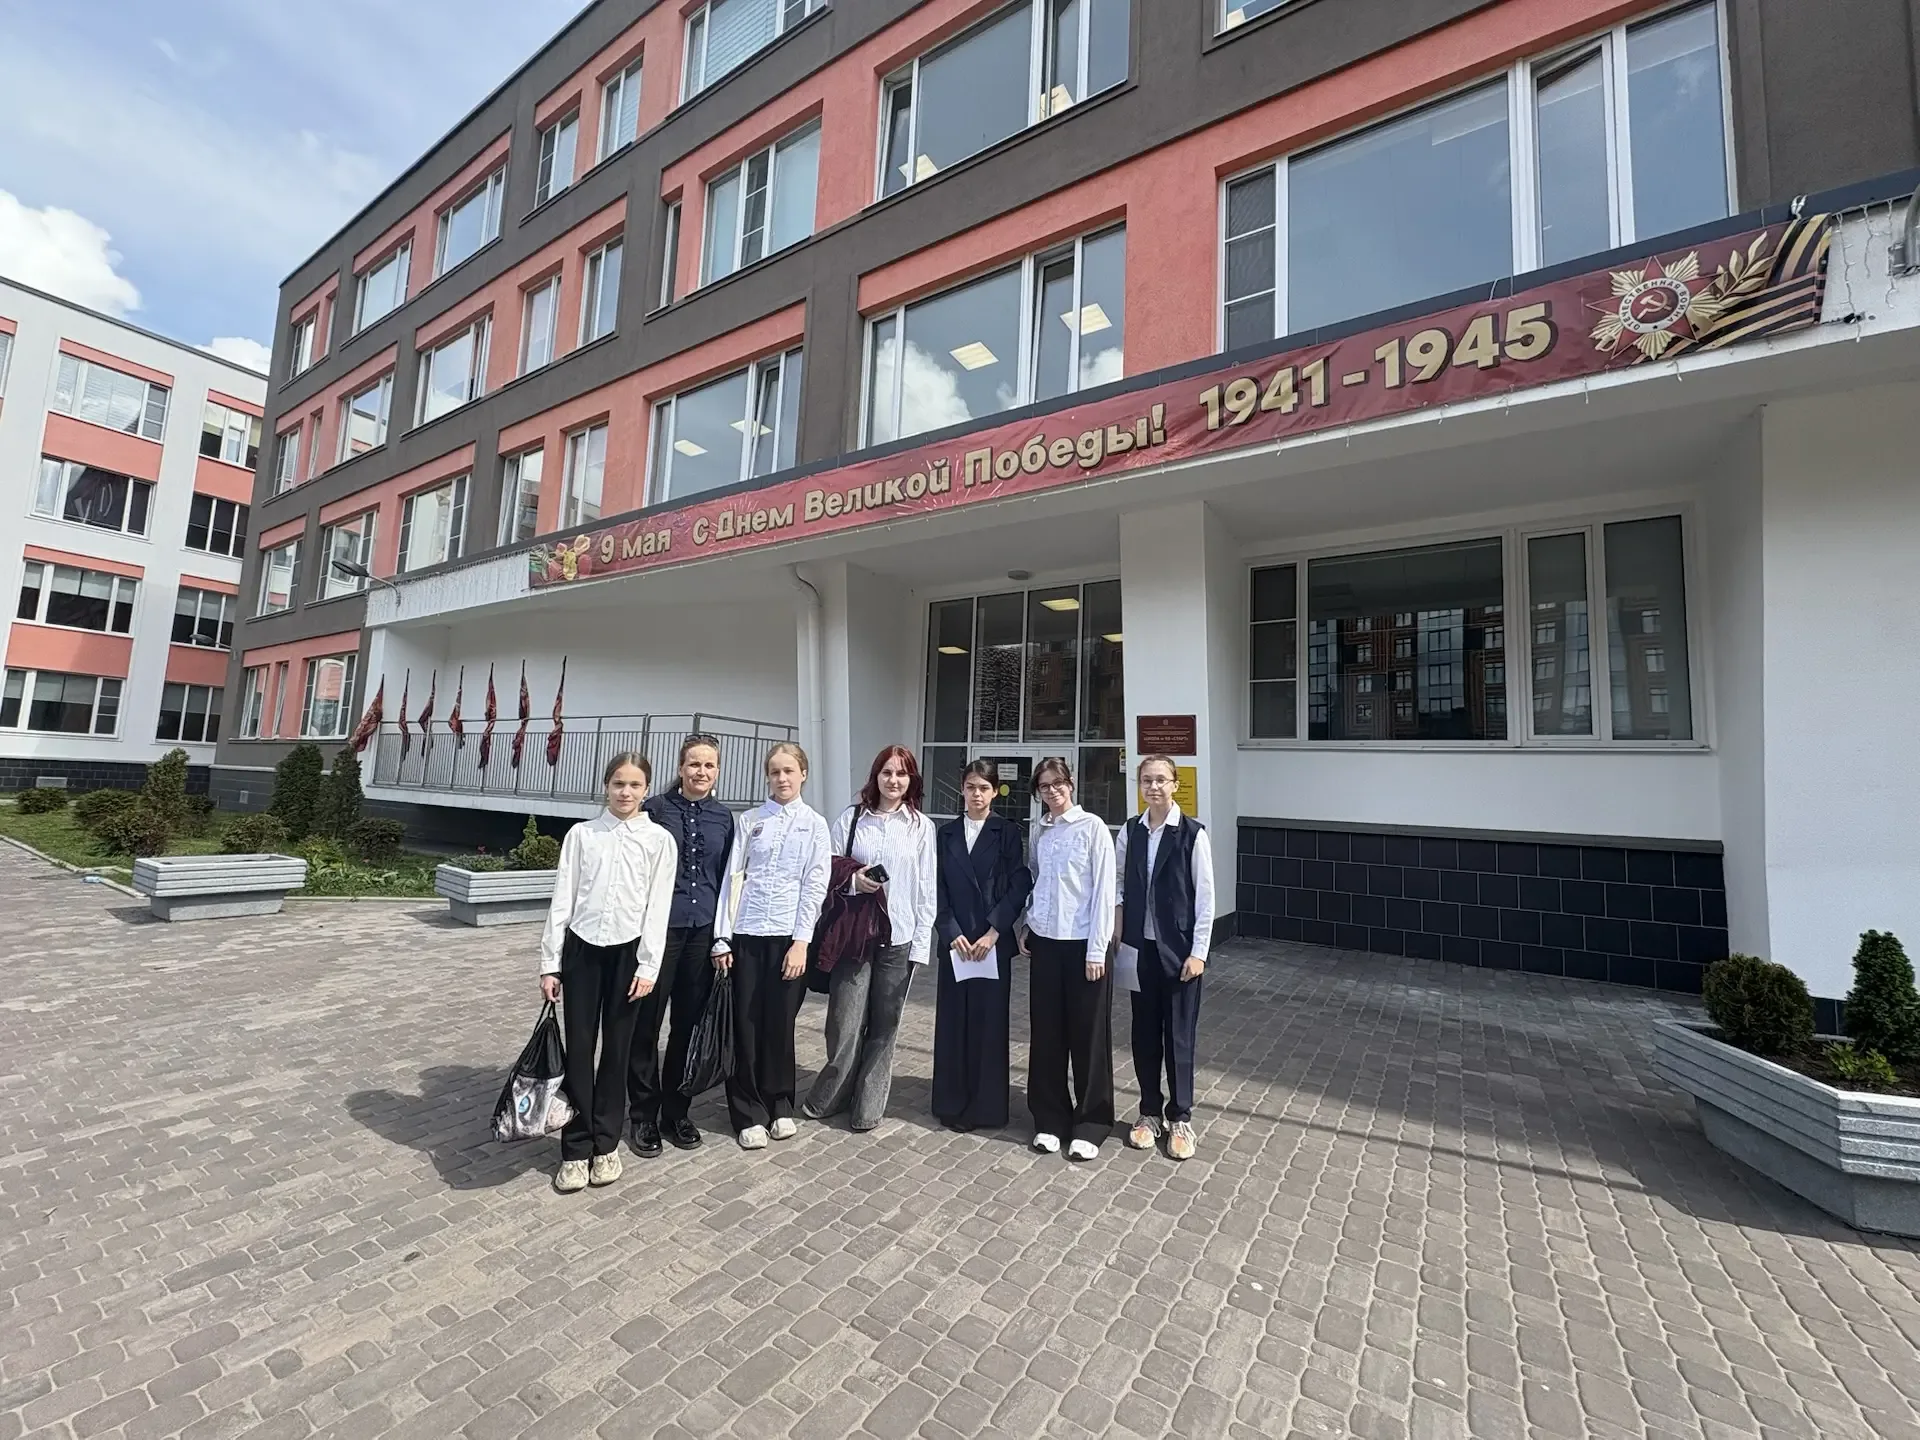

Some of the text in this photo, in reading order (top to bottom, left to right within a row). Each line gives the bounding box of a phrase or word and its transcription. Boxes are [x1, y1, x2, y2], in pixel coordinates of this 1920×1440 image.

[1622, 280, 1681, 331] ОТЕЧЕСТВЕННАЯ
[600, 534, 615, 564] 9
[621, 528, 672, 560] мая
[715, 503, 795, 541] Днем
[804, 457, 951, 522] Великой
[964, 403, 1167, 488] Победы!
